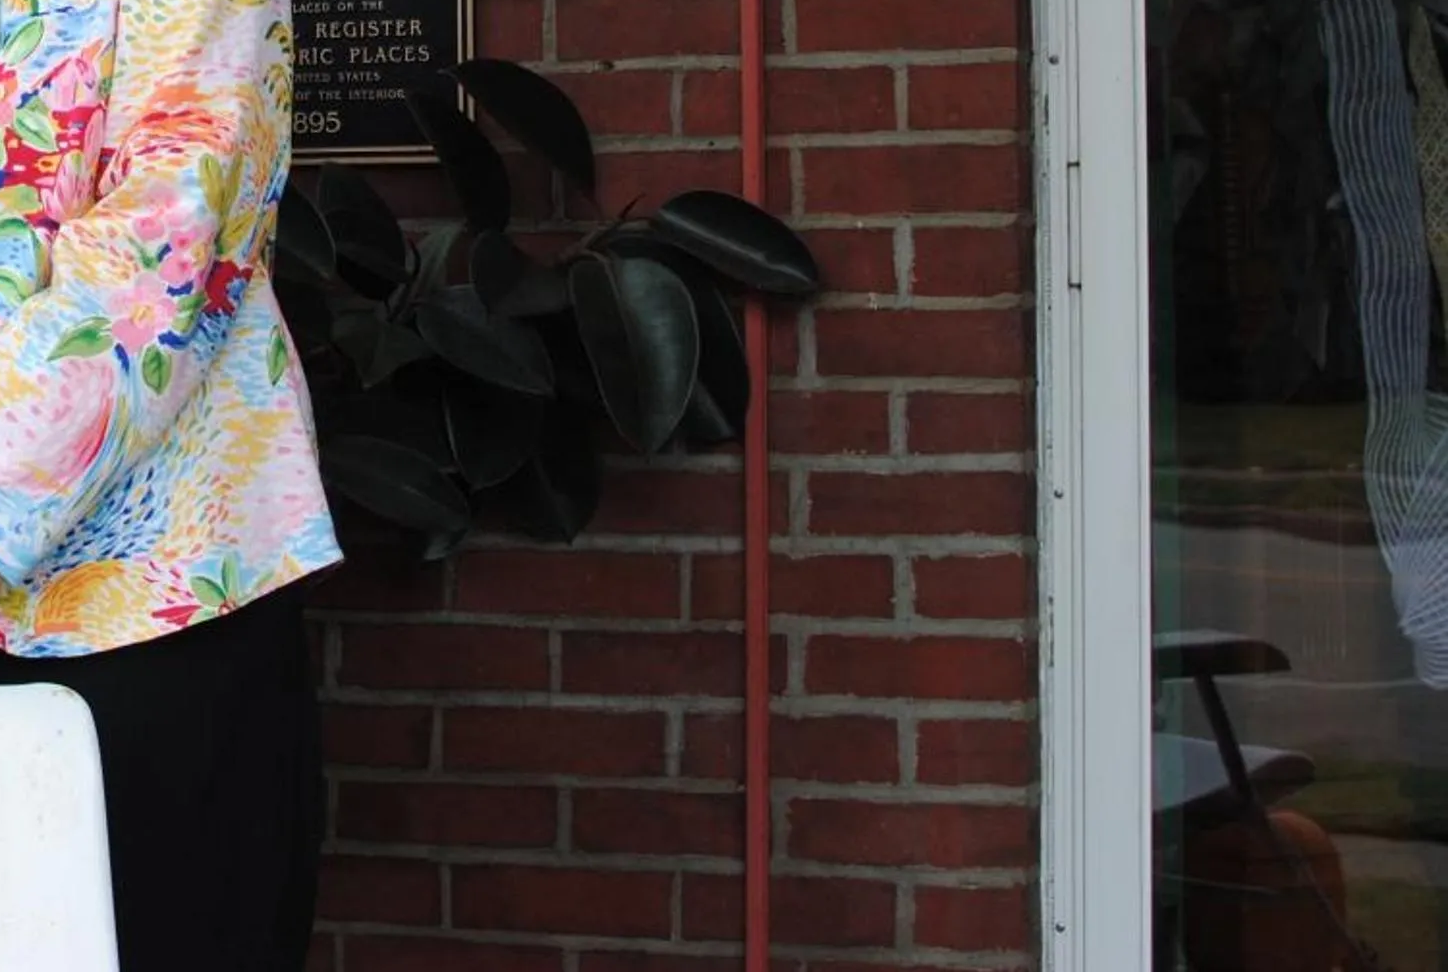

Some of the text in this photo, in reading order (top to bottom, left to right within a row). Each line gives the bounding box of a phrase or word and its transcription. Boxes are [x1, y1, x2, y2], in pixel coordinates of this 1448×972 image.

[292, 0, 384, 14] LACED ON THE
[315, 18, 423, 39] REGISTER
[297, 43, 430, 66] RIC PLACES
[293, 72, 331, 84] NITED
[292, 111, 342, 135] 895
